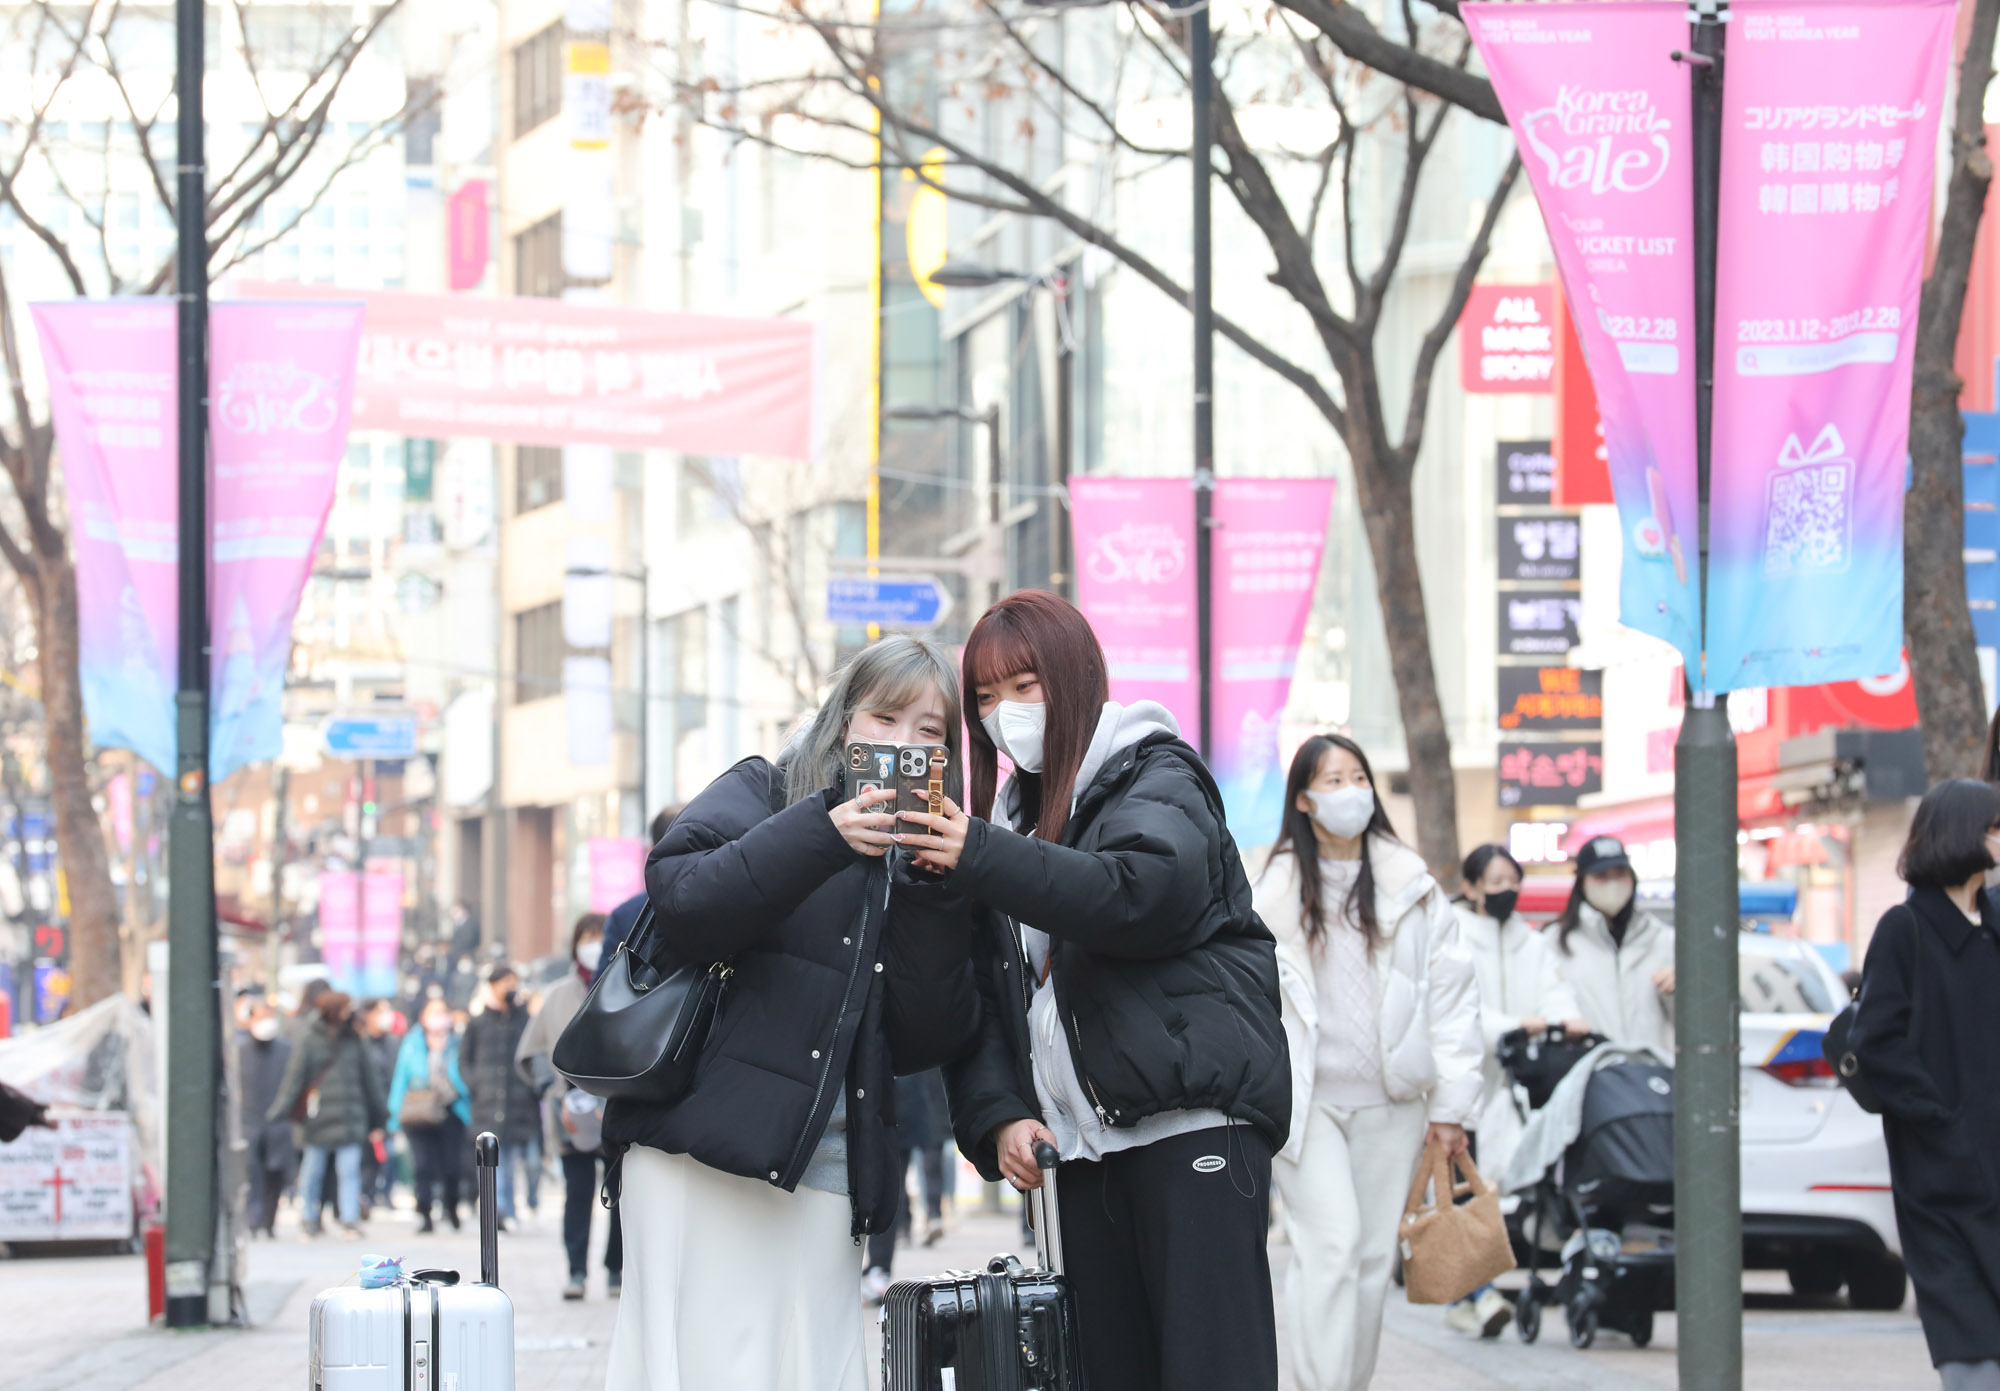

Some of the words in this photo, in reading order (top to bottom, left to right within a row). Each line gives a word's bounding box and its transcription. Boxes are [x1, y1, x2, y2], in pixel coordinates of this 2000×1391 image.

[1513, 31, 1557, 43] KOREA
[1557, 29, 1593, 43] YEAR
[1744, 27, 1776, 40] VISIT
[1778, 28, 1824, 41] KOREA
[1824, 26, 1860, 39] YEAR
[1556, 84, 1649, 116] Korea
[1562, 105, 1658, 136] Grand
[1743, 99, 1927, 130] コリアグランドセール
[1638, 237, 1677, 256] LIST
[1494, 296, 1542, 323] ALL
[1481, 354, 1556, 381] STORY
